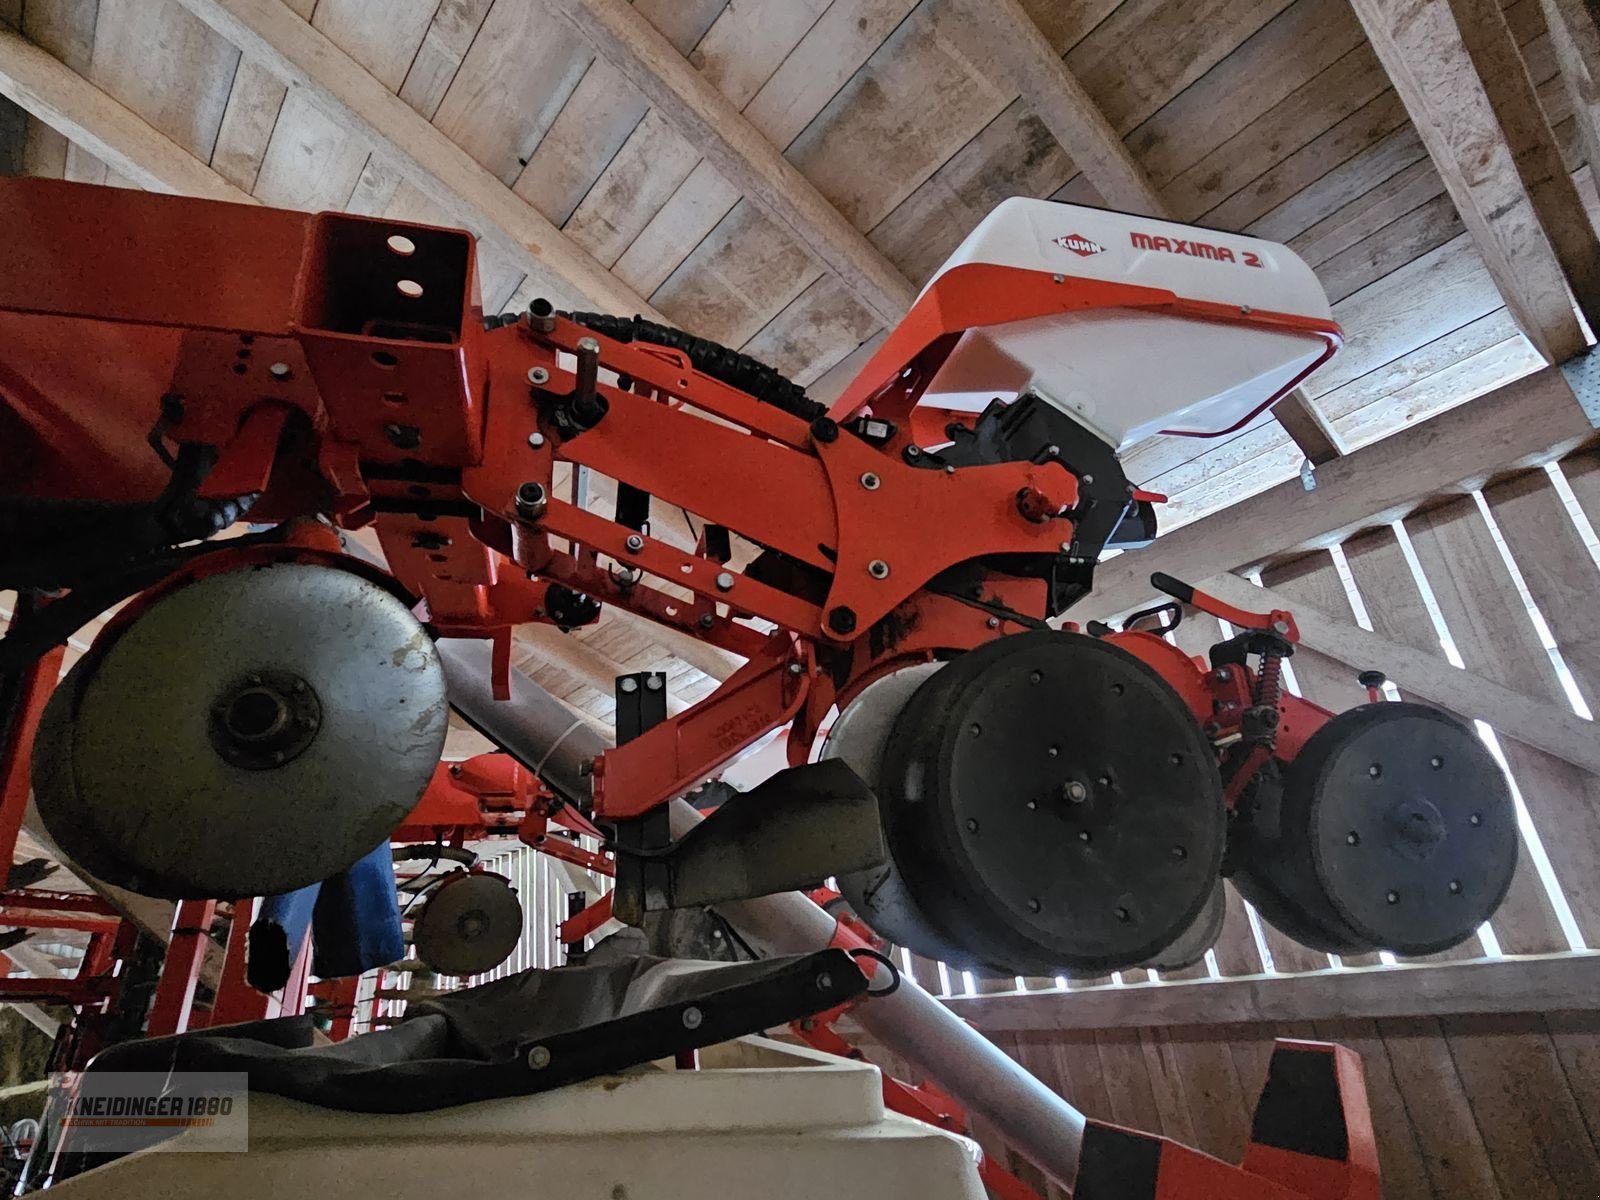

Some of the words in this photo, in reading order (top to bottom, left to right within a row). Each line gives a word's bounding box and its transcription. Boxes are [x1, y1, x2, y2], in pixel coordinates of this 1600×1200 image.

[1056, 236, 1103, 254] KUHN
[1130, 232, 1236, 263] MAXIMA
[1241, 252, 1263, 268] 2
